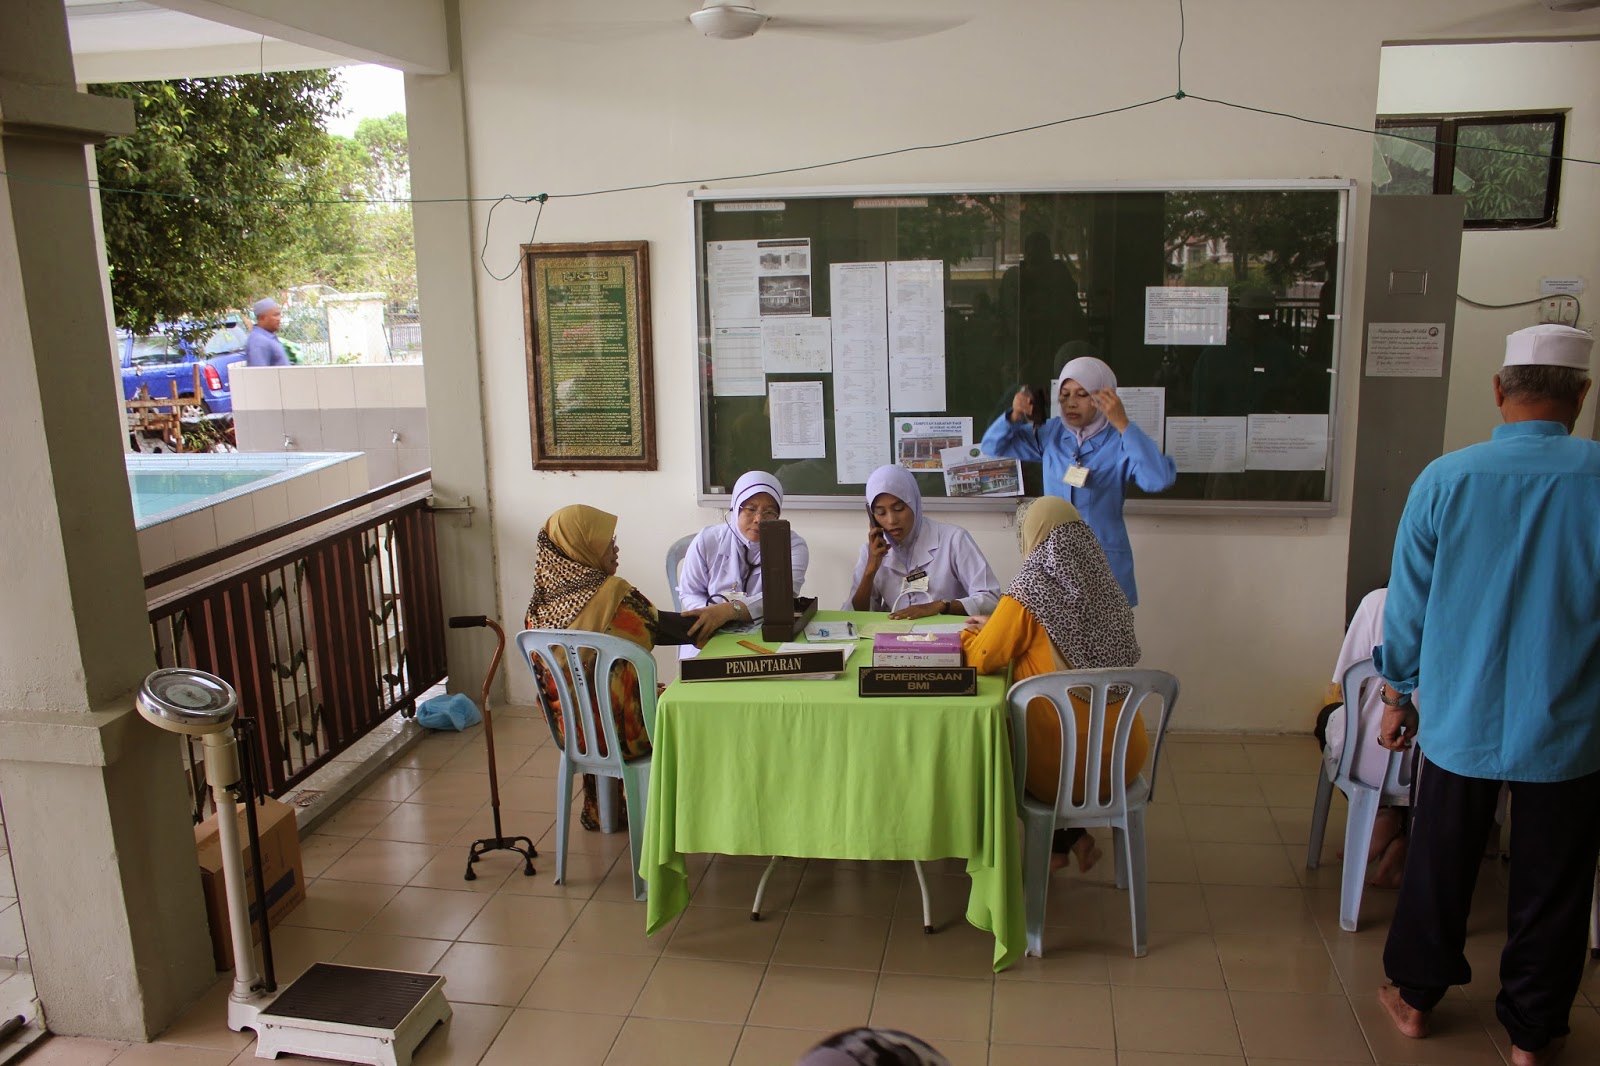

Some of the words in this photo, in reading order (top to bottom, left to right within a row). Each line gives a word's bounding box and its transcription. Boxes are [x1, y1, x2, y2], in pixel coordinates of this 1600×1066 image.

[726, 658, 802, 674] PENDAFTARAN
[875, 673, 962, 681] PEMERIKSAAN
[907, 682, 930, 690] BMI
